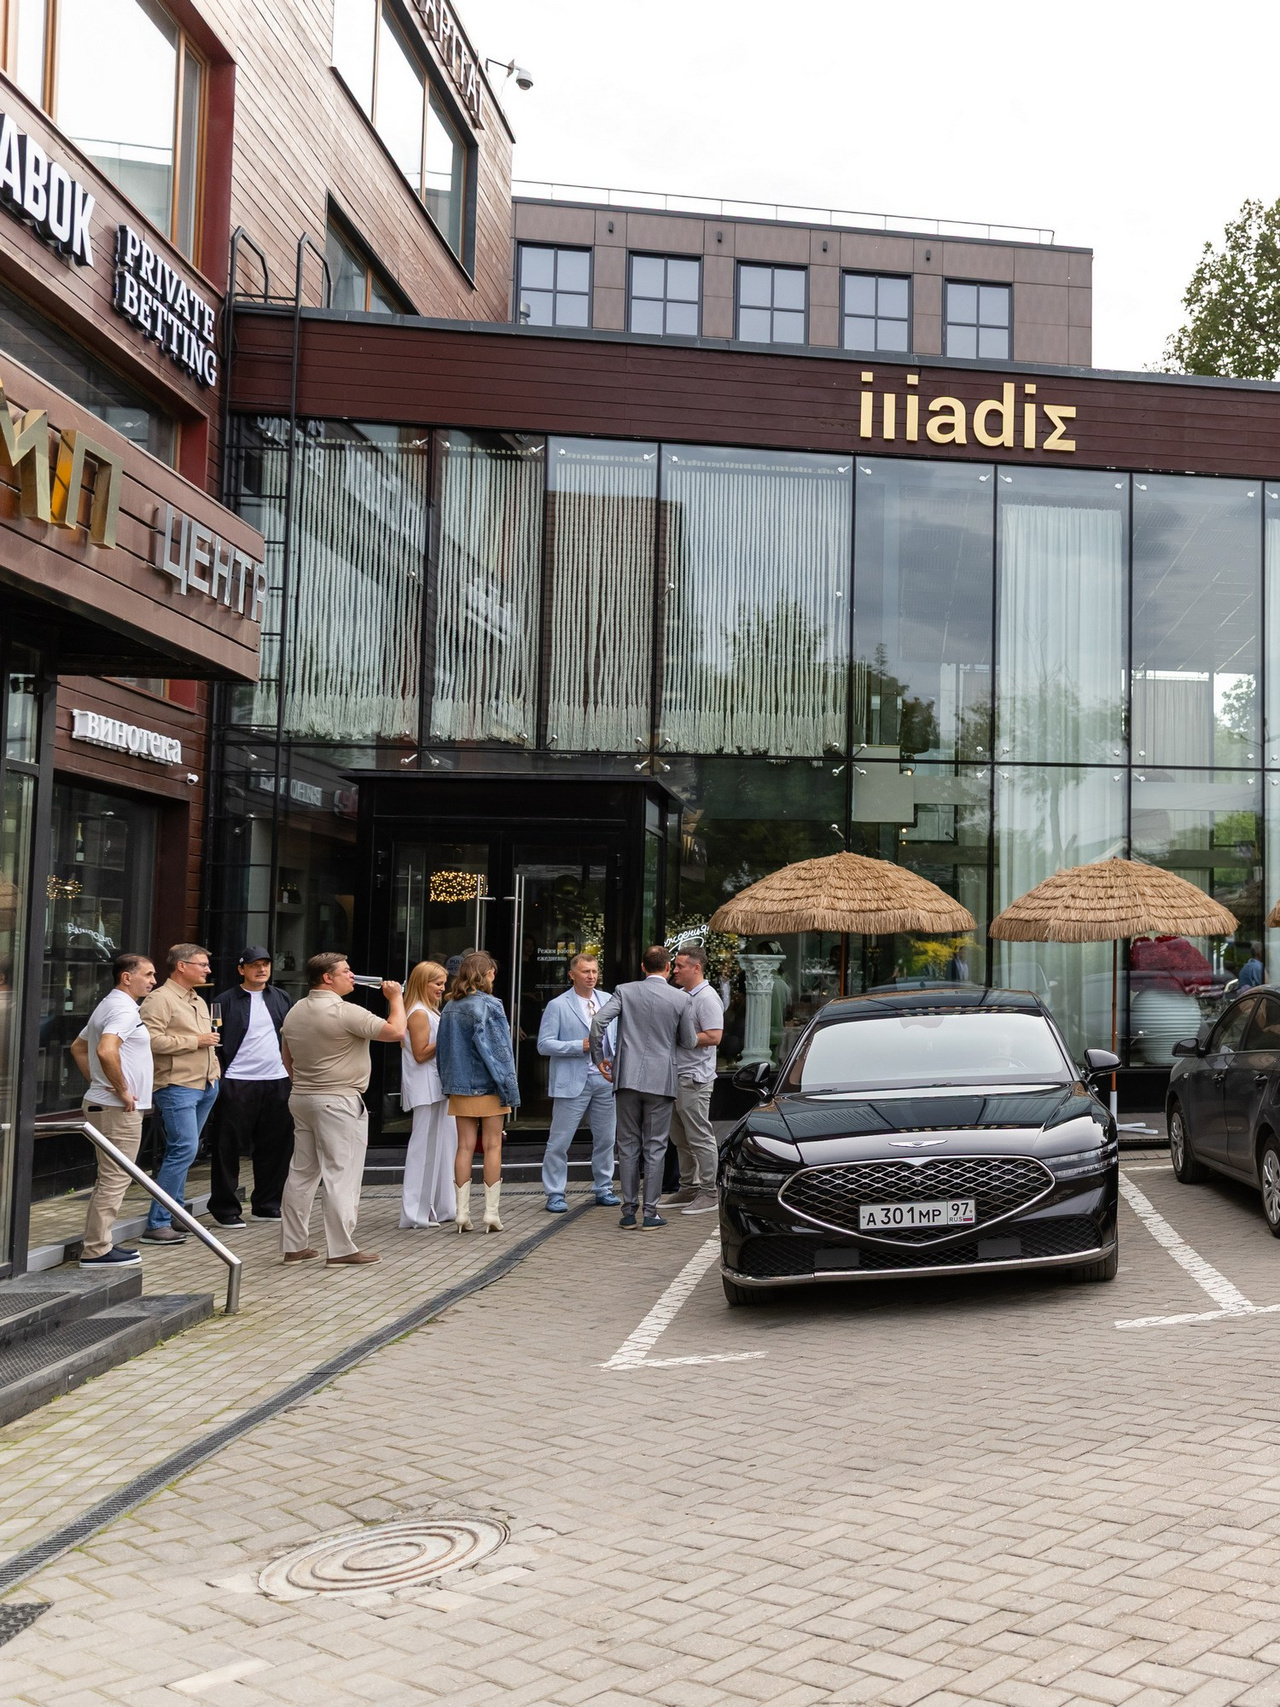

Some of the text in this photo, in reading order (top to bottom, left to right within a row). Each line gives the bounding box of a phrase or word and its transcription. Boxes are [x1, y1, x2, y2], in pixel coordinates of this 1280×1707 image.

[122, 270, 218, 387] BETTING
[124, 224, 216, 344] PRIVATE
[161, 502, 269, 622] ЦЕНТР
[951, 1202, 969, 1216] 97
